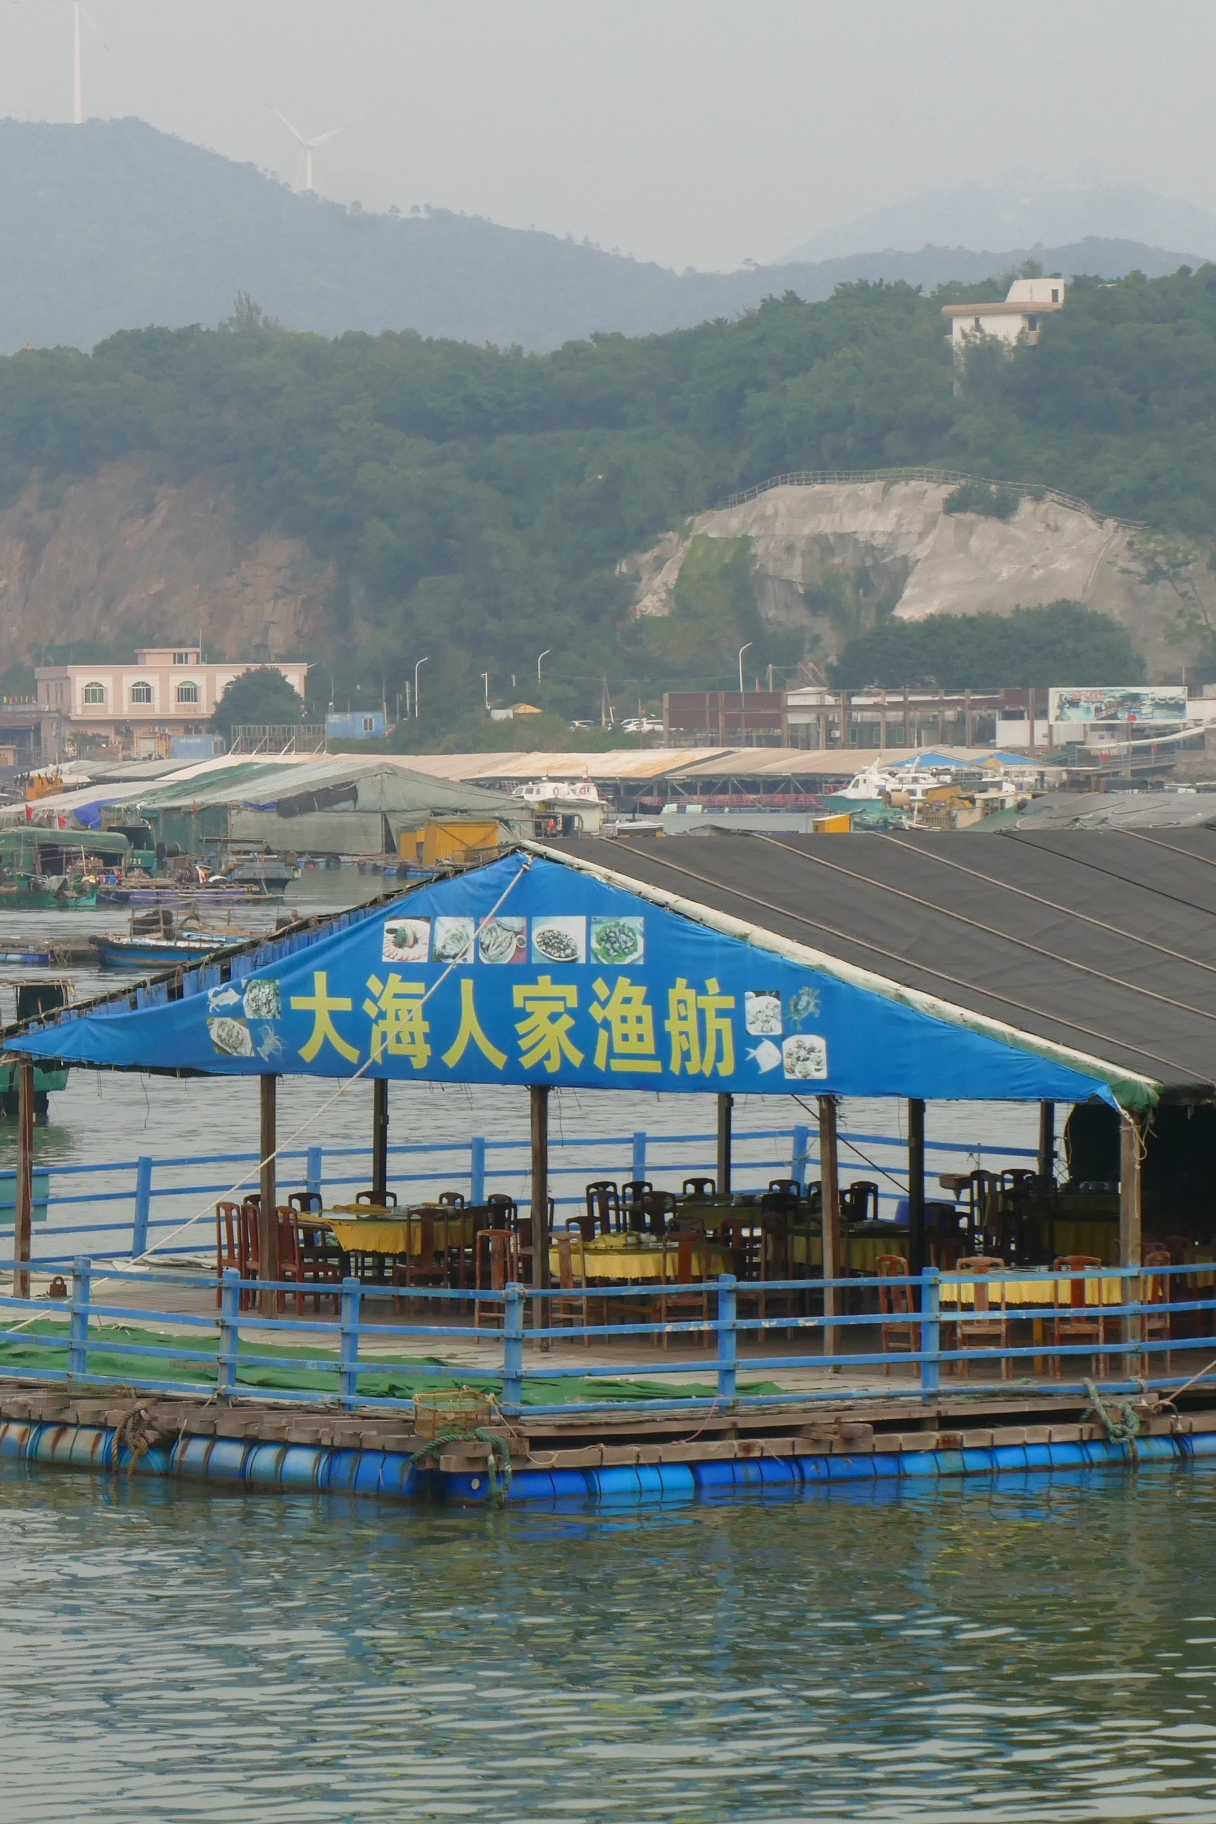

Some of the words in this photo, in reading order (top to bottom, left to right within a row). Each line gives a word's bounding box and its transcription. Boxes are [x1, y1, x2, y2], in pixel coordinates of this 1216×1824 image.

[290, 971, 735, 1078] 大海人家渔舫
